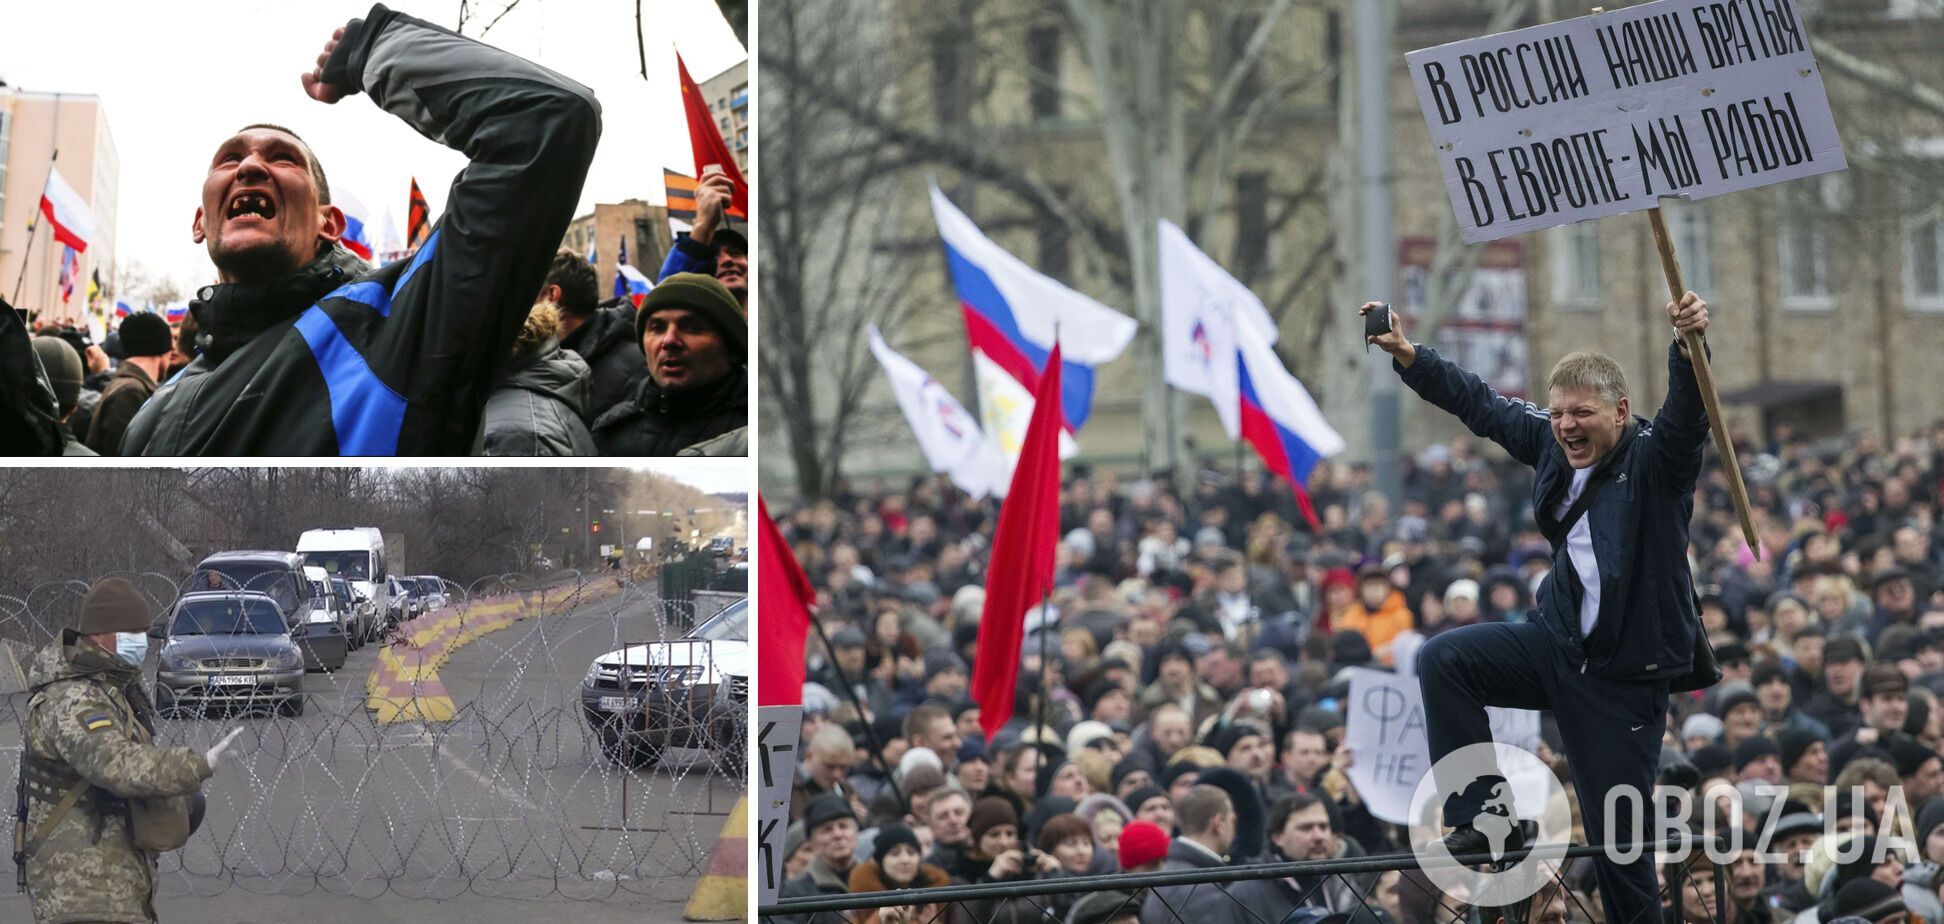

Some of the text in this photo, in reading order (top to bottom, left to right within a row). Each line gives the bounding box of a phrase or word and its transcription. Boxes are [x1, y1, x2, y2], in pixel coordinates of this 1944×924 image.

[1423, 0, 1805, 125] В РОССИИ НАШИ БРАТЬЯ
[1455, 156, 1495, 228] В
[1701, 92, 1814, 180] РАБЫ
[1363, 684, 1427, 745] ФА
[1373, 753, 1419, 786] НЕ
